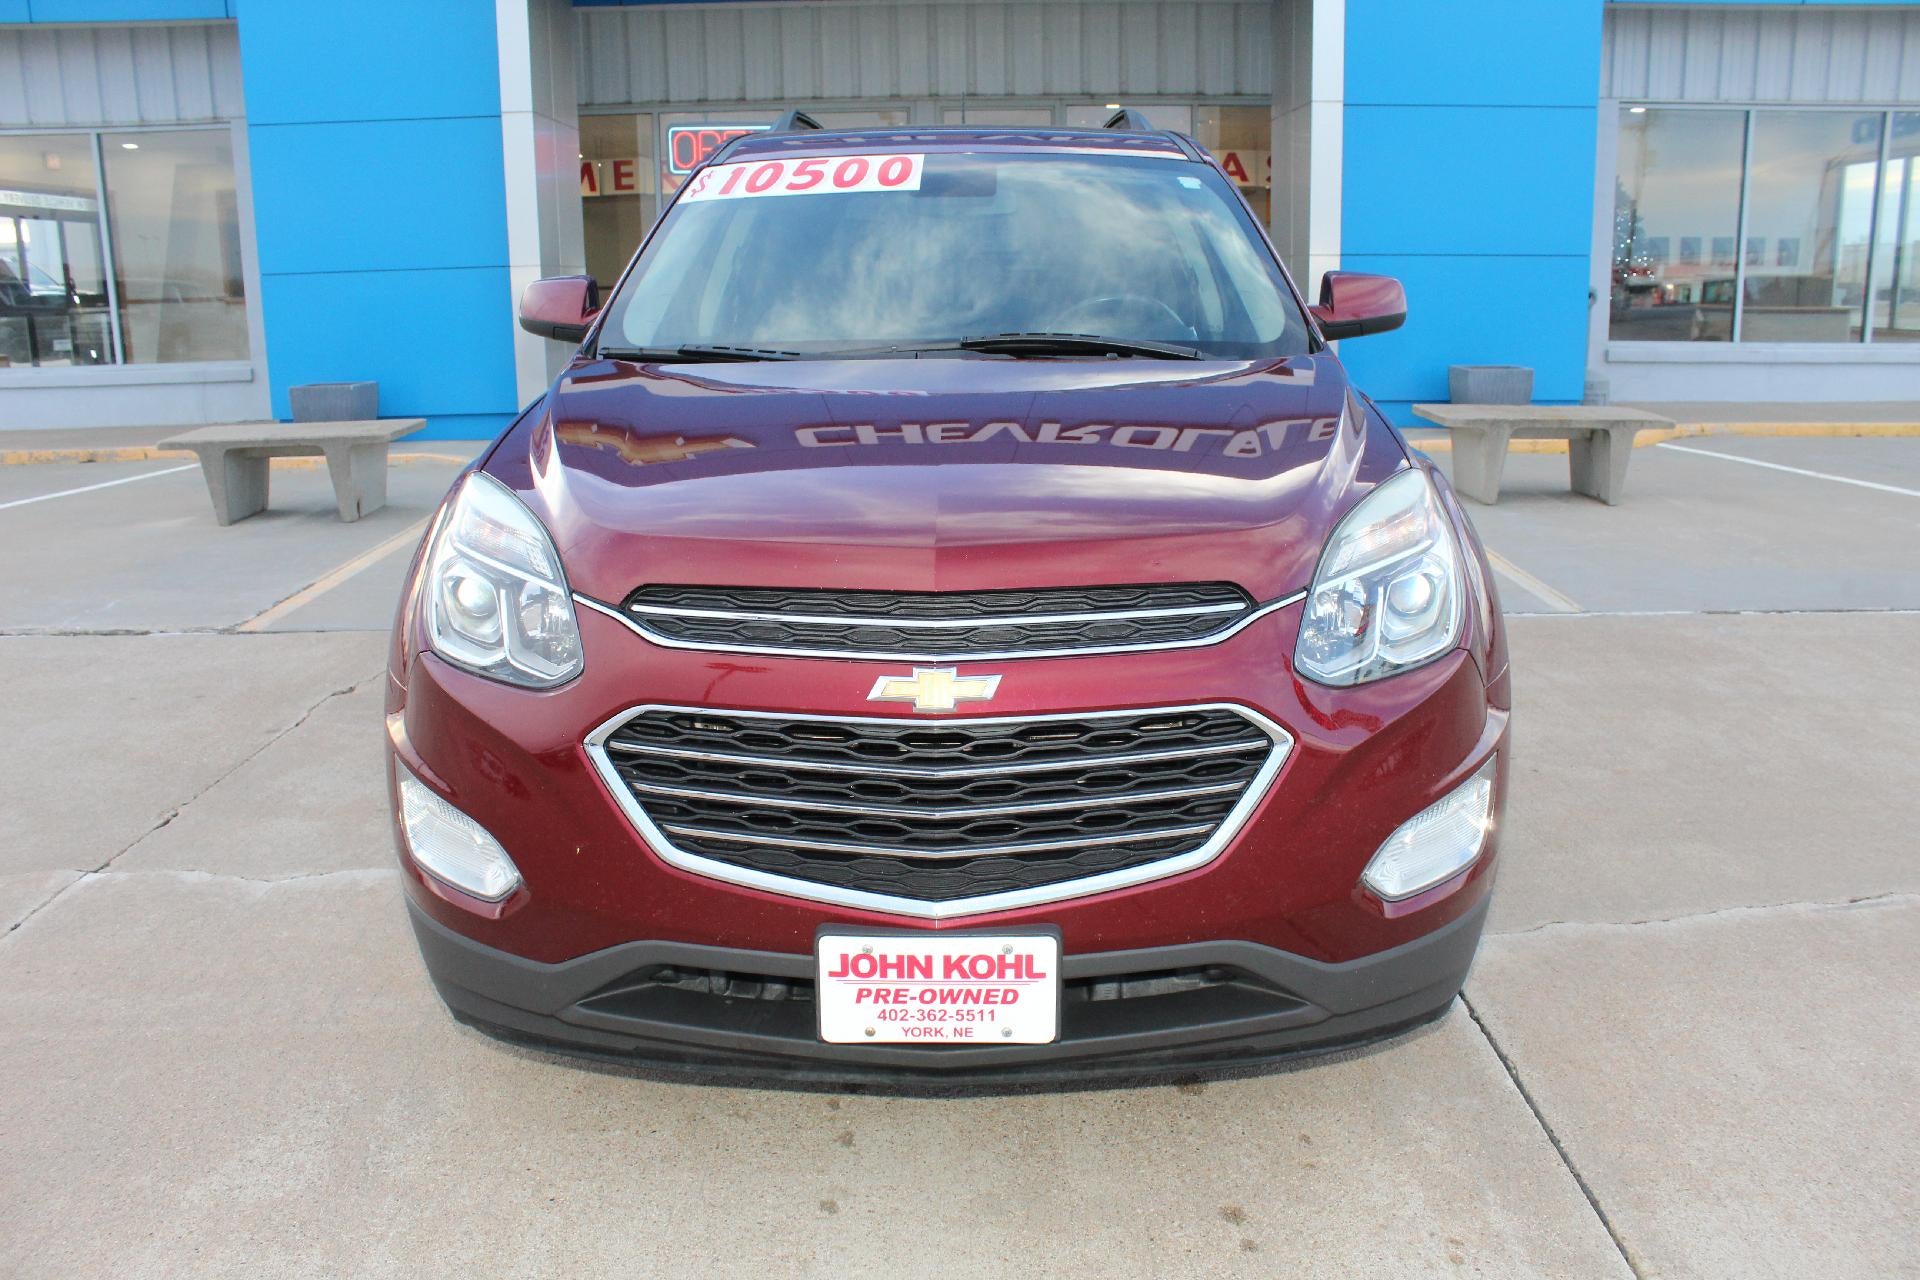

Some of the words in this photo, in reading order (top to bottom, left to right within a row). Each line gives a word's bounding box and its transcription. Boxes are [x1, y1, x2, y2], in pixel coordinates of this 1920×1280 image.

[691, 156, 913, 198] $10500
[828, 953, 933, 979] JOHN
[943, 954, 1046, 979] KOHL
[855, 988, 1020, 1005] PRE-OWNED
[877, 1009, 996, 1022] 402-362-5511
[901, 1027, 949, 1039] YORK,
[953, 1027, 974, 1038] NE
